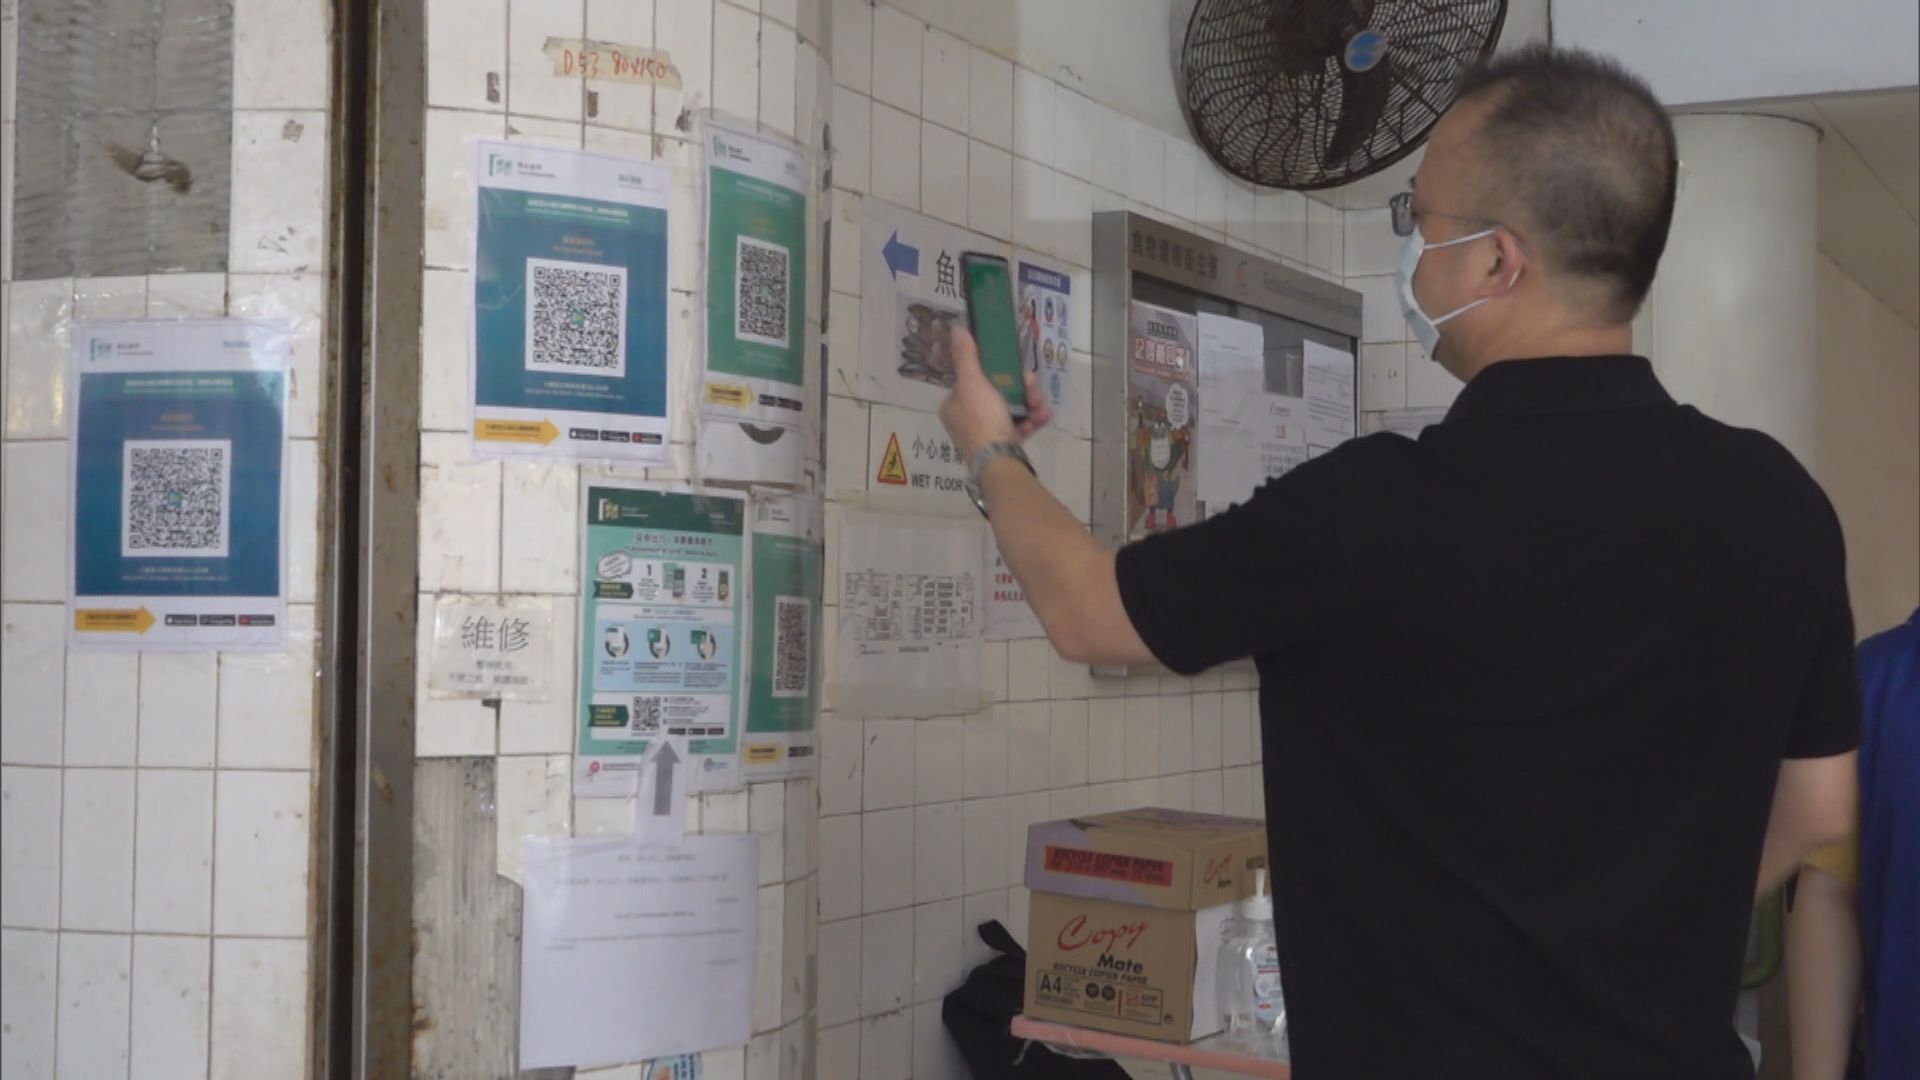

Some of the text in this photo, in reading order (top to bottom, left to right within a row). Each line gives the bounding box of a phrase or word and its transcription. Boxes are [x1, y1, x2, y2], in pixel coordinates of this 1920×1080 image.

[911, 474, 963, 491] WET FLOOR
[461, 615, 530, 652] 維修
[1057, 914, 1149, 953] Copy
[1053, 961, 1087, 976] RECYCLE
[1120, 972, 1148, 985] PAPER
[1097, 953, 1144, 974] Mate
[1039, 973, 1063, 995] A4
